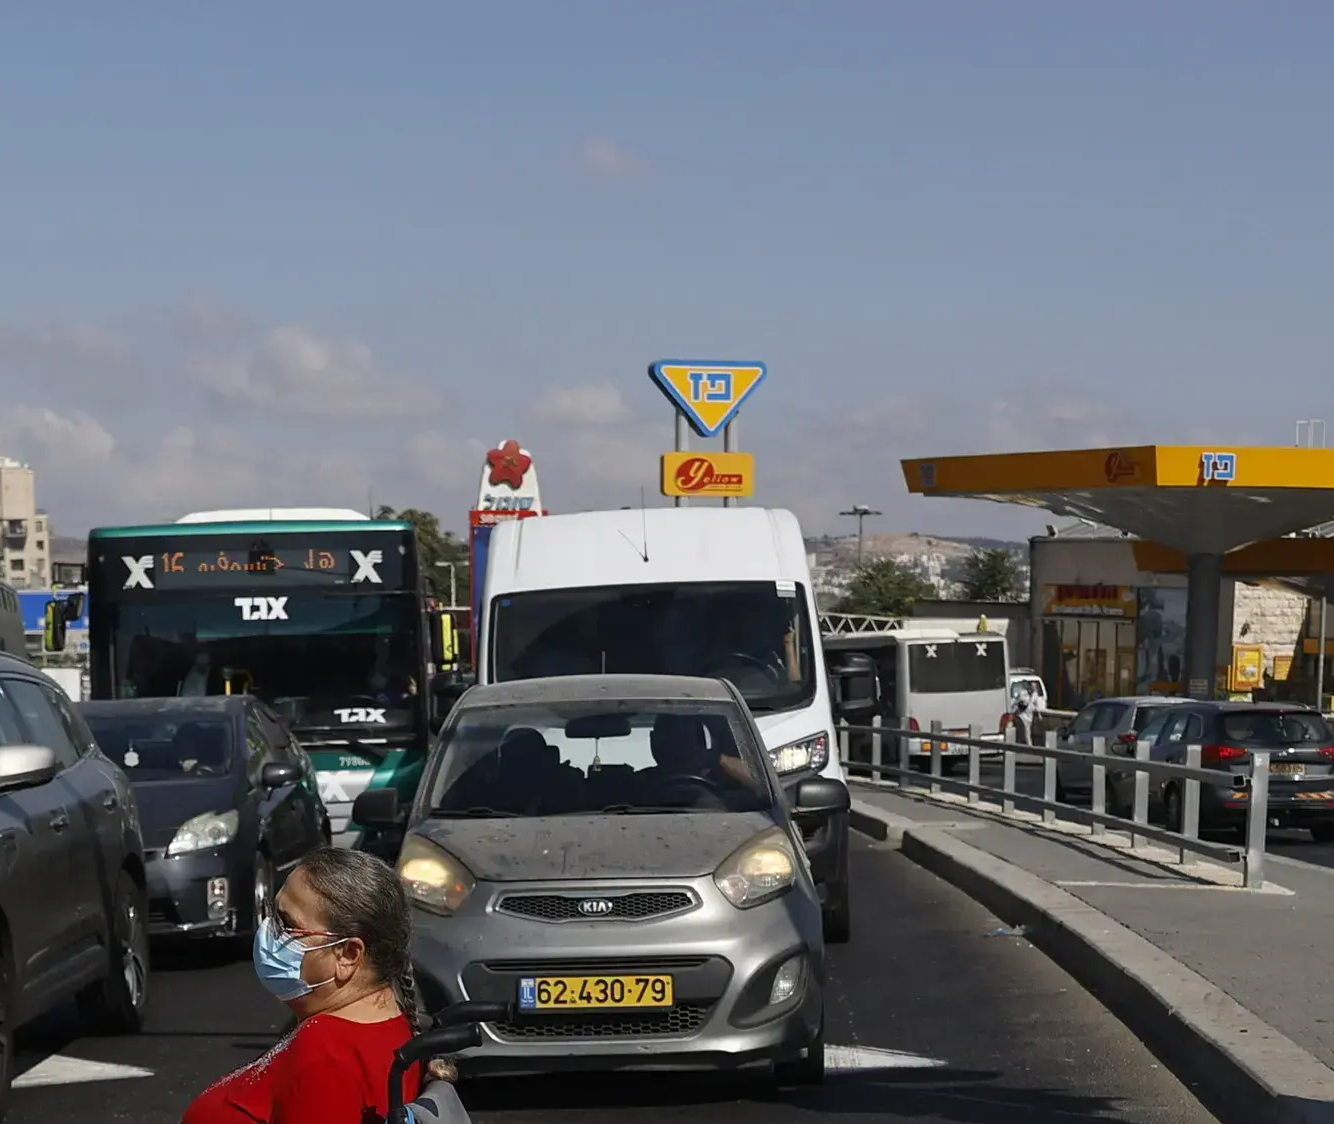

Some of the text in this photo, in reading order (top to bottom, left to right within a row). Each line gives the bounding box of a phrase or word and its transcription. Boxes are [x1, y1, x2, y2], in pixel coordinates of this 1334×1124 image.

[688, 371, 733, 402] פז
[677, 460, 743, 489] Yellow
[1201, 452, 1236, 480] פז
[234, 597, 289, 620] אגד
[333, 708, 387, 723] אגד
[583, 902, 608, 912] KIA
